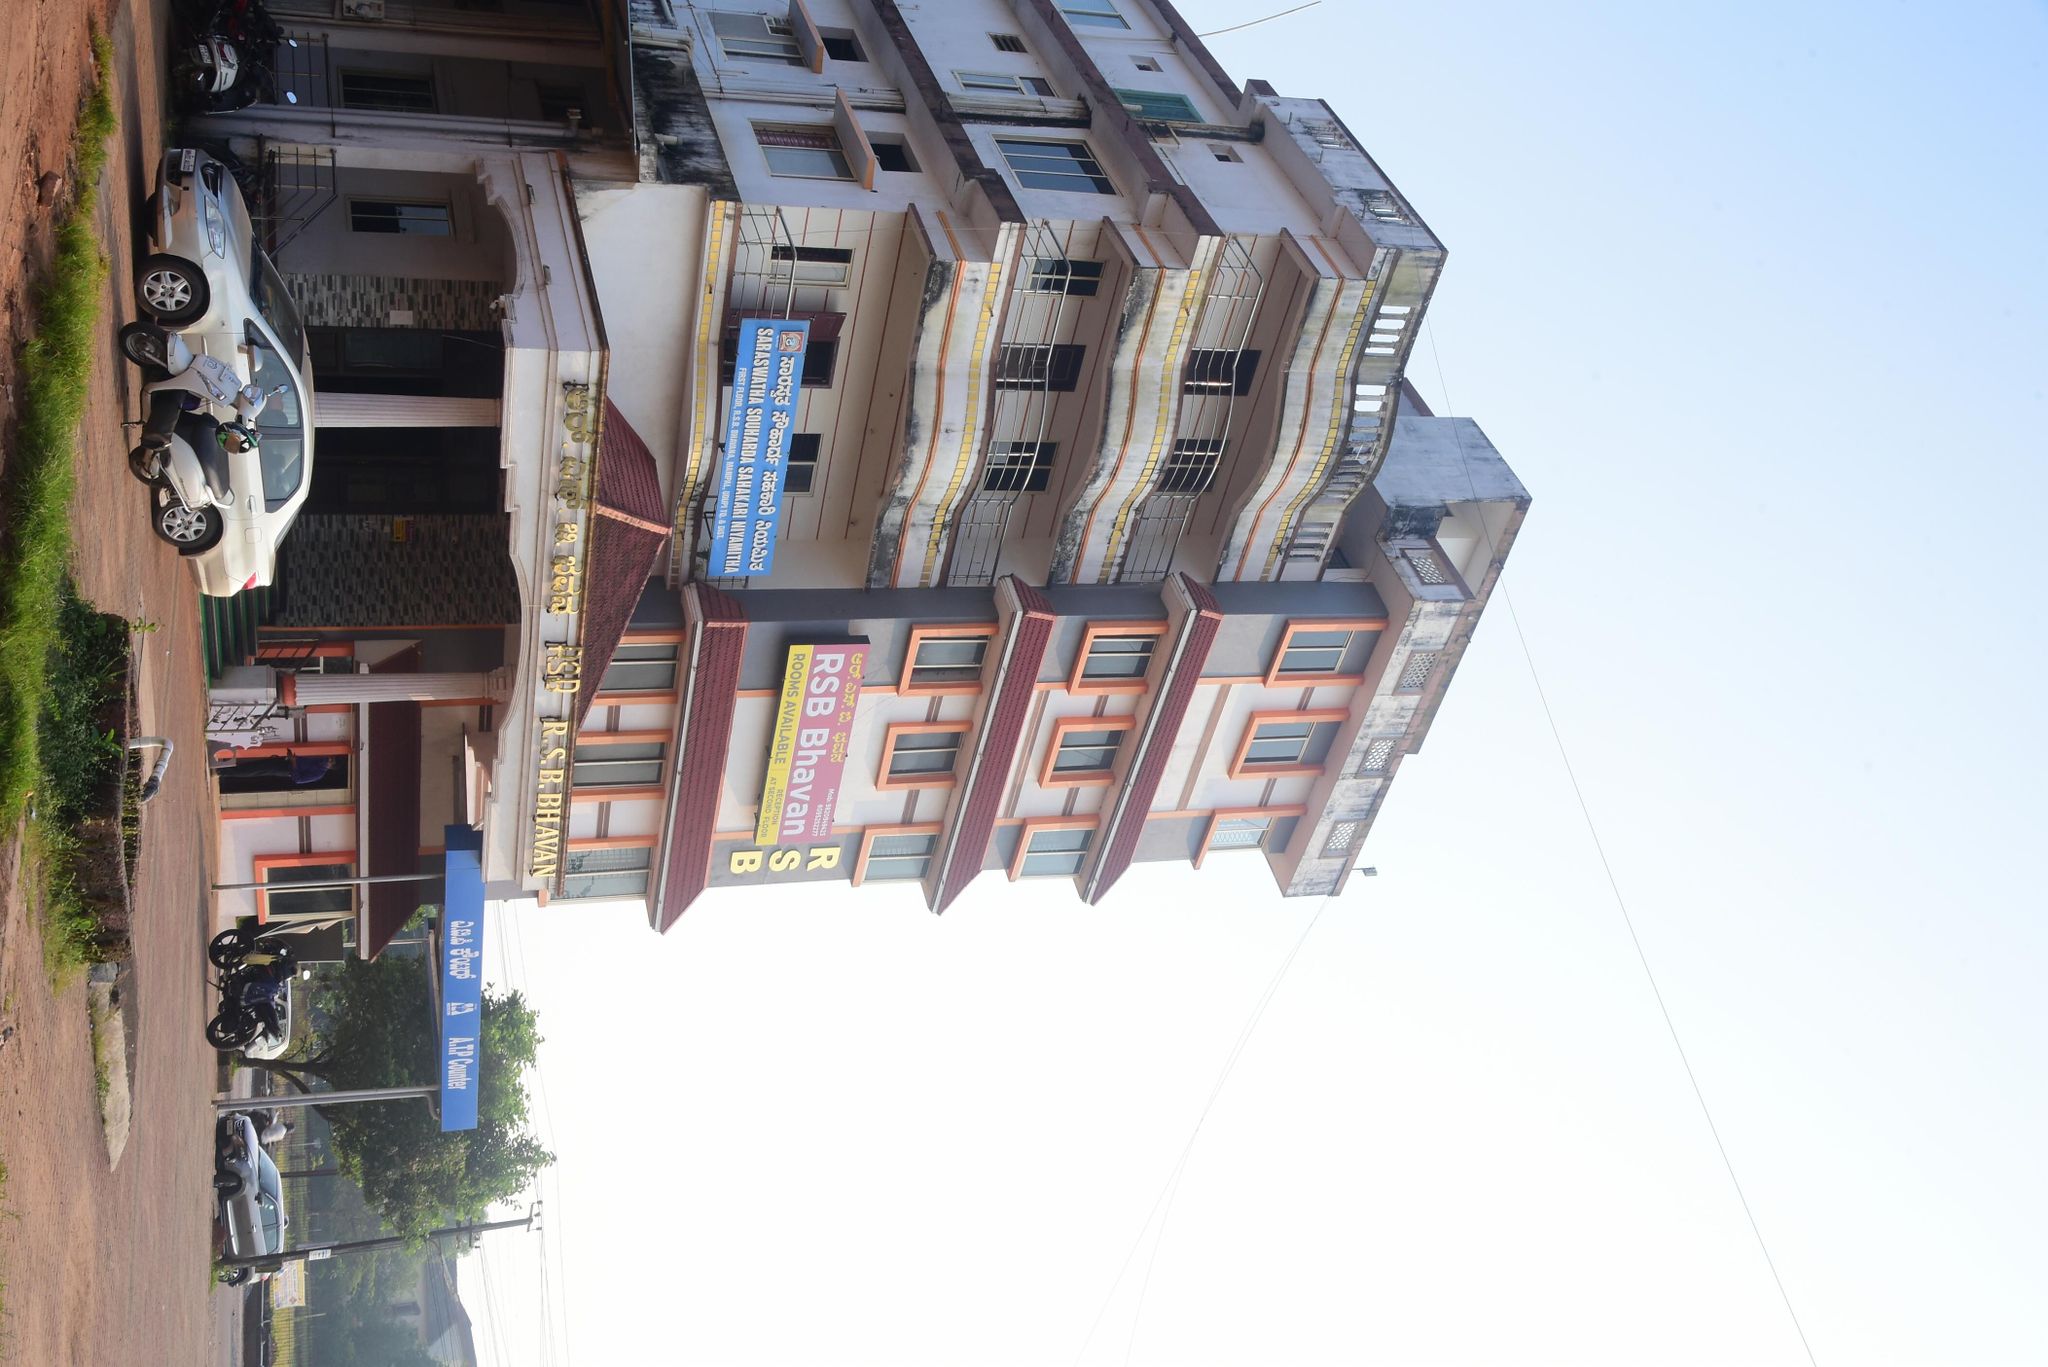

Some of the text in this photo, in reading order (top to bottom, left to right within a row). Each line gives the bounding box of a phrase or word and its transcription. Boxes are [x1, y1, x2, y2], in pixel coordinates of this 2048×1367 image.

[736, 367, 748, 386] FIRST
[770, 356, 795, 406] ಸಾರಸ್ವತ
[724, 328, 774, 574] SARASWATHA SOUHARDA SAHAKARI NIYAMITHA
[758, 471, 778, 516] ಸಹಕಾರಿ
[748, 520, 772, 571] ನಿಯಮಿತ
[549, 555, 584, 615] ಭವನ
[774, 653, 806, 764] ROOMS AVAILABLE
[782, 654, 845, 836] RSB Bhavan
[830, 732, 848, 763] ಭವನ
[760, 776, 777, 838] AT SECOND FLOOR
[771, 789, 784, 825] RECEPTION
[448, 1037, 472, 1090] A.T.P Counter
